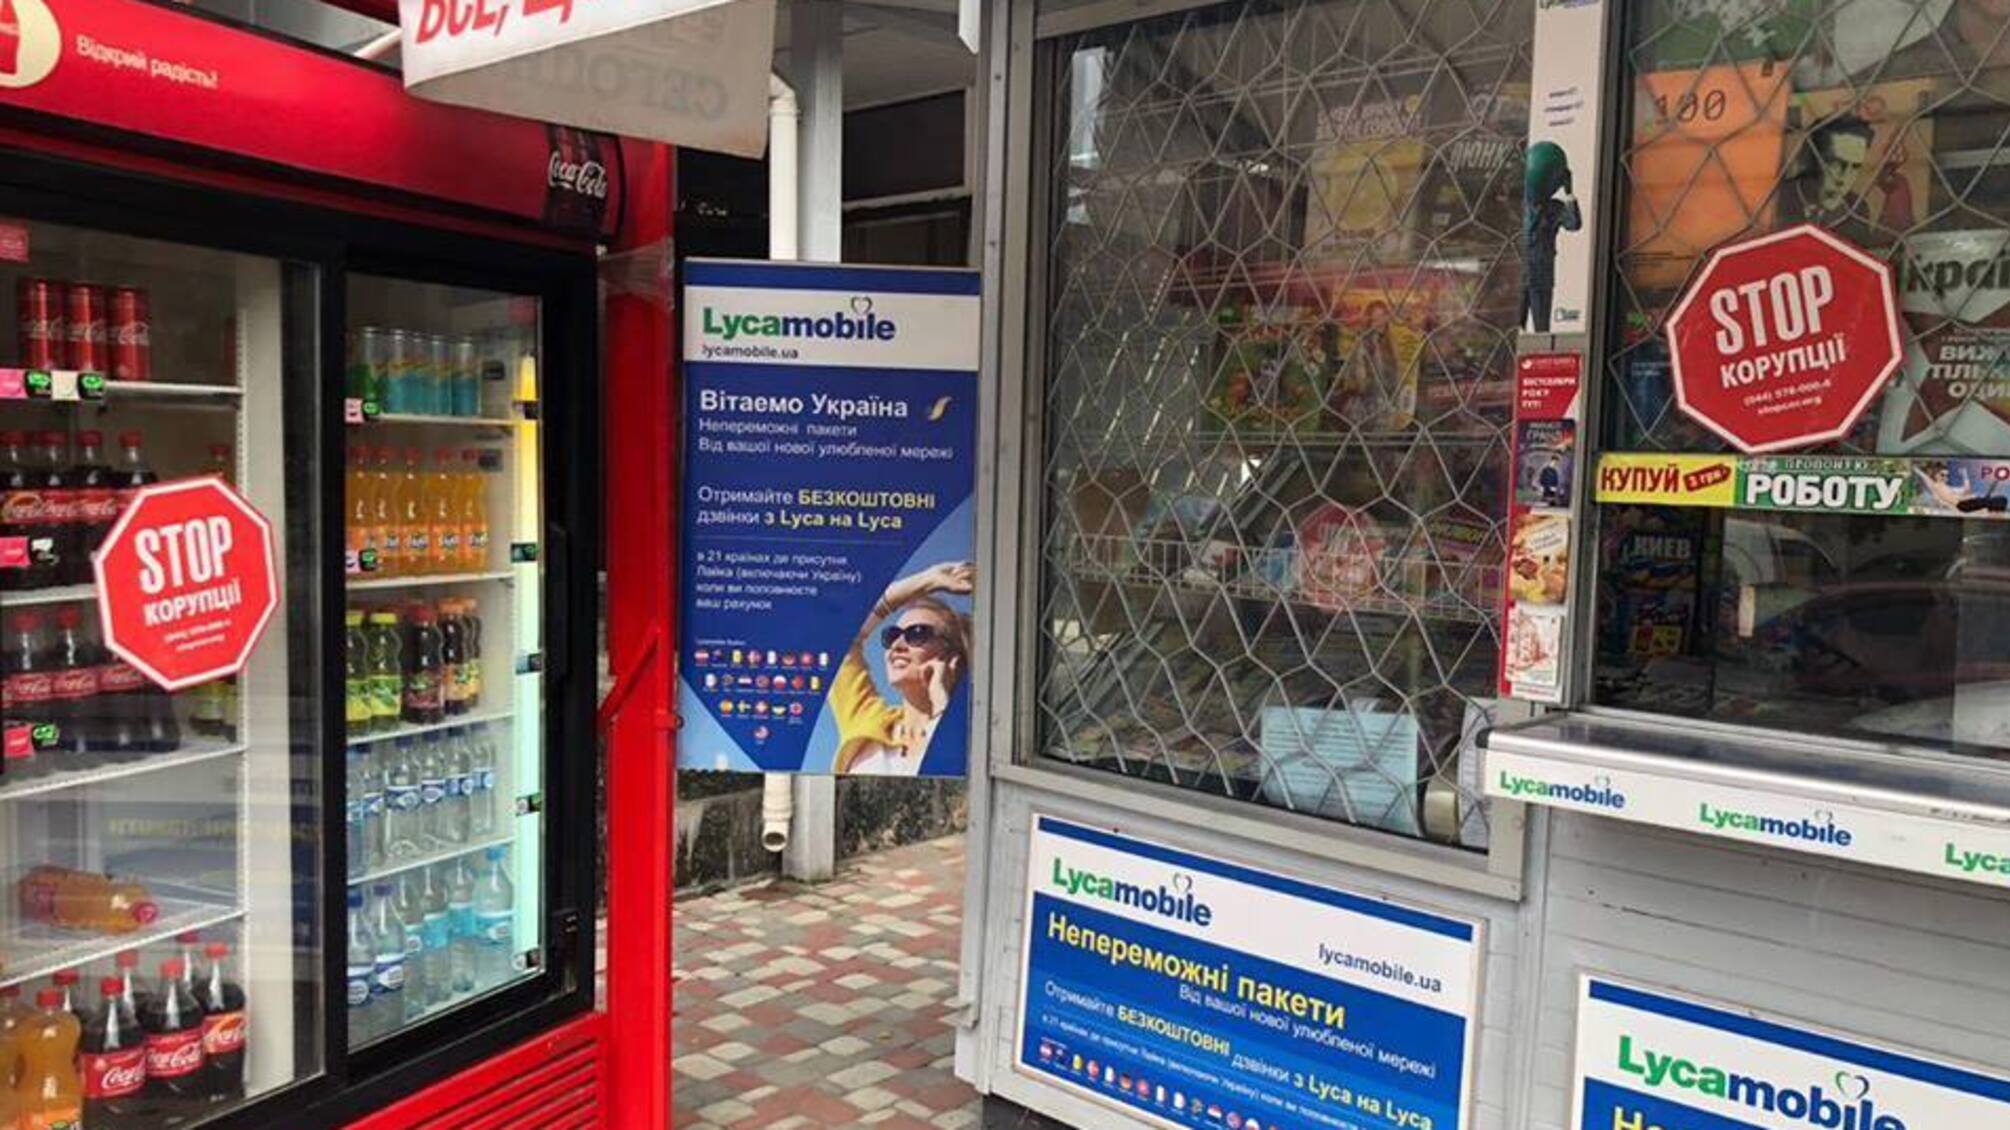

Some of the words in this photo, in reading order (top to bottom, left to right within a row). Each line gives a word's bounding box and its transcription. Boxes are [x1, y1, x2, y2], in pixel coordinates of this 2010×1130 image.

[703, 299, 896, 341] Lycamobile
[1710, 265, 1834, 356] STOP
[702, 344, 799, 359] lycamobile.ua
[1720, 333, 1846, 390] КОРУПЦІЇ
[699, 418, 799, 436] Непереможні
[806, 424, 857, 436] пакети
[811, 393, 908, 420] Україна
[699, 439, 723, 453] Від
[726, 440, 771, 453] вашої
[773, 442, 814, 454] нової
[818, 442, 897, 458] улюбленої
[899, 446, 953, 460] мережі
[697, 486, 793, 508] Отримайте
[798, 489, 936, 508] БЕЗКОШТОВНІ
[1600, 463, 1680, 494] КУПУЙ
[1746, 474, 1904, 511] РОБОТУ
[697, 509, 760, 526] дзвінки
[763, 512, 775, 526] з
[780, 510, 824, 529] Lyca
[829, 515, 852, 527] на
[858, 512, 903, 532] Lyca
[134, 516, 233, 596] STOP
[144, 577, 243, 627] КОРУПЦІЇ
[1499, 770, 1626, 810] Lycamobile
[1699, 804, 1853, 847] Lycamobile
[1945, 843, 2010, 875] Lyca
[1052, 858, 1212, 928] Lycamobile
[1047, 911, 1229, 994] Непереможні
[1236, 975, 1348, 1031] пакети
[1318, 942, 1443, 994] lycamobile.ua
[1179, 984, 1202, 1006] Від
[1205, 994, 1247, 1020] вашої
[1250, 1008, 1290, 1031] нової
[1292, 1021, 1375, 1060] улюбленої
[1378, 1050, 1436, 1080] мережі
[1044, 980, 1115, 1018] Отримайте
[1116, 1004, 1231, 1056] БЕЗКОШТОВНІ
[1231, 1053, 1291, 1084] дзвінки
[1308, 1074, 1353, 1104] Lyca
[1356, 1094, 1381, 1115] на
[1386, 1099, 1433, 1130] Lyca
